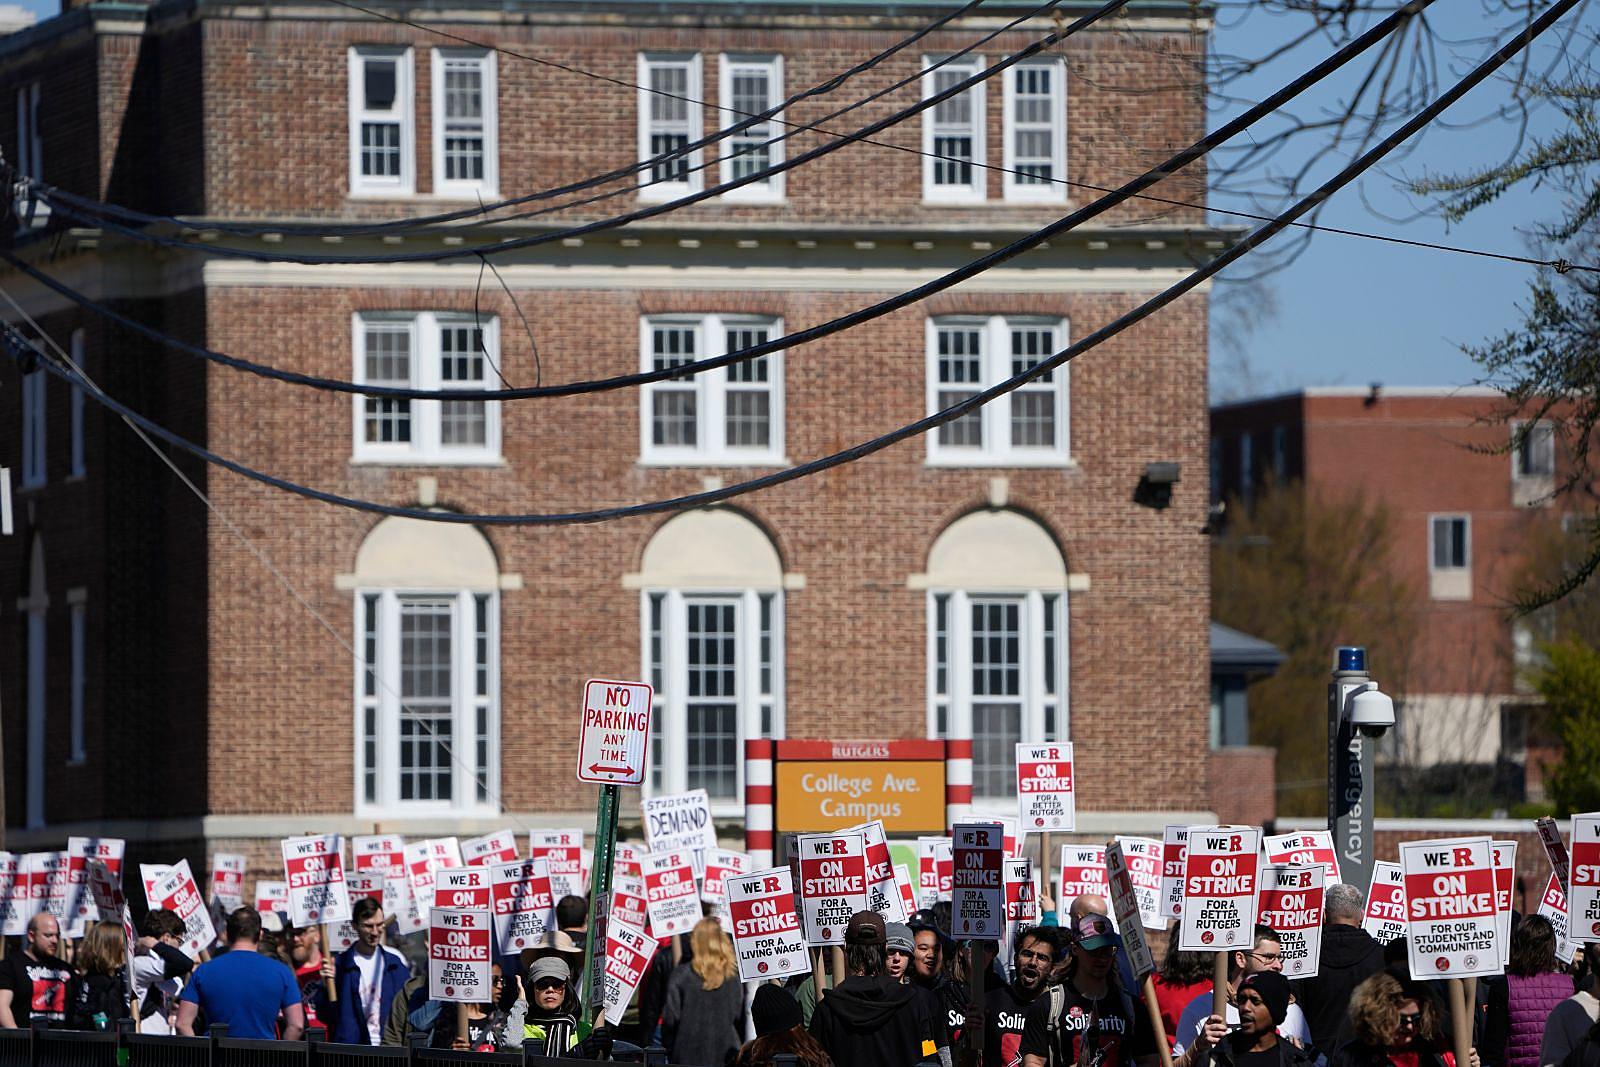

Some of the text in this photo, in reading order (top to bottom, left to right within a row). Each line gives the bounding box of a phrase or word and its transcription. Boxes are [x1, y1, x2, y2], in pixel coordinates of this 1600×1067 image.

[606, 688, 630, 706] NO
[587, 709, 646, 732] PARKING
[604, 734, 626, 746] ANY
[600, 749, 626, 762] TIME
[832, 746, 889, 758] RUTGERS
[1032, 748, 1060, 760] WE R
[1036, 764, 1056, 778] ON
[802, 773, 920, 798] College Ave.
[1021, 777, 1070, 792] STRIKE
[1345, 727, 1362, 864] mergency
[820, 798, 902, 821] Campus
[650, 807, 707, 838] DEMAND
[382, 840, 392, 850] R
[544, 834, 570, 844] WE R
[963, 831, 990, 846] WE R
[1206, 835, 1242, 852] WE R
[1282, 836, 1317, 850] WE R
[297, 841, 326, 854] WE R
[475, 840, 502, 852] WE R
[814, 840, 848, 855] WE R
[1130, 844, 1160, 858] WE R
[370, 854, 391, 868] ON
[547, 848, 568, 860] ON
[654, 854, 682, 868] WE R
[965, 853, 984, 868] ON
[1078, 852, 1094, 862] WE
[1290, 850, 1314, 863] ON
[1424, 848, 1474, 868] WE R
[304, 857, 325, 872] ON
[732, 856, 742, 868] R
[820, 861, 844, 877] ON
[1131, 859, 1154, 873] ON
[1210, 859, 1237, 876] ON
[290, 868, 342, 887] STRIKE
[504, 864, 535, 878] WE R
[660, 870, 680, 886] ON
[956, 869, 1000, 886] STRIKE
[1014, 867, 1026, 878] WE
[1080, 869, 1102, 883] ON
[361, 879, 372, 889] R
[450, 873, 480, 886] WE R
[742, 882, 762, 894] WE
[763, 877, 782, 893] R
[806, 876, 864, 895] STRIKE
[1188, 875, 1252, 894] STRIKE
[1277, 872, 1312, 888] WE R
[1432, 875, 1466, 896] ON
[174, 888, 189, 905] ON
[510, 882, 533, 897] ON
[648, 880, 695, 901] STRIKE
[964, 891, 984, 900] FOR A
[1391, 889, 1402, 903] O
[452, 892, 475, 906] ON
[496, 893, 550, 914] STRIKE
[624, 897, 640, 912] ON
[821, 898, 848, 908] FOR A
[962, 900, 988, 910] BETTER
[1206, 900, 1235, 910] FOR A
[1280, 894, 1306, 910] ON
[1411, 893, 1492, 918] STRIKE
[751, 900, 777, 918] ON
[818, 907, 852, 917] BETTER
[960, 910, 990, 919] RUTGERS
[1200, 910, 1238, 920] BETTER
[444, 914, 475, 928] WE R
[514, 914, 530, 922] FOR
[736, 912, 799, 935] STRIKE
[1260, 907, 1319, 926] STRIKE
[1552, 912, 1565, 922] FOR
[511, 920, 542, 930] BETTER
[1196, 919, 1240, 929] RUTGERS
[1383, 922, 1402, 932] FOR
[1431, 922, 1476, 934] FOR OUR
[448, 932, 470, 946] ON
[508, 927, 546, 938] RUTGERS
[1298, 932, 1303, 940] A
[1414, 930, 1494, 944] STUDENTS AND
[618, 928, 645, 952] WE R
[756, 937, 784, 948] FOR A
[433, 944, 487, 960] STRIKE
[741, 943, 802, 960] LIVING WAGE
[1418, 941, 1492, 954] COMMUNITIES
[614, 945, 635, 966] ON
[446, 962, 463, 970] FOR
[606, 958, 640, 984] TRIKE
[440, 976, 480, 986] RUTGERS
[443, 970, 476, 978] BETTER
